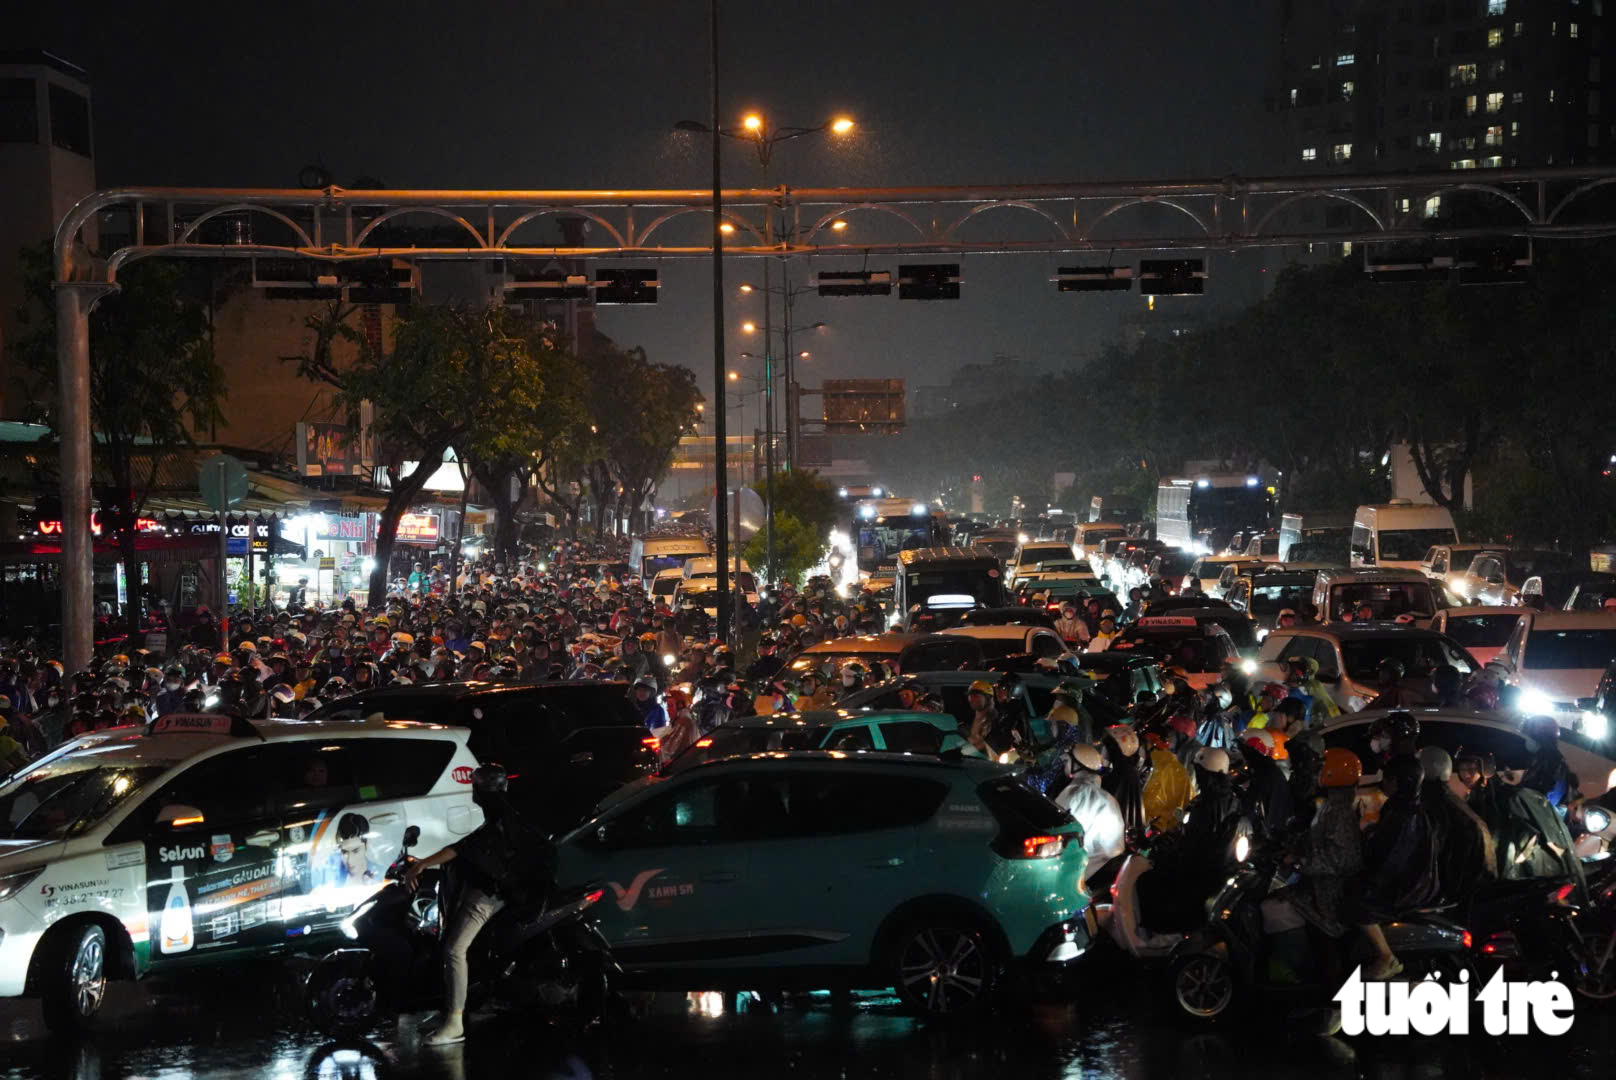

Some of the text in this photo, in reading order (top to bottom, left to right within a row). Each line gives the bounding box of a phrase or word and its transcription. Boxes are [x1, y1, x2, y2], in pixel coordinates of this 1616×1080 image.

[159, 845, 205, 862] Selsun
[58, 881, 97, 892] VINASUN
[648, 886, 677, 897] XANH
